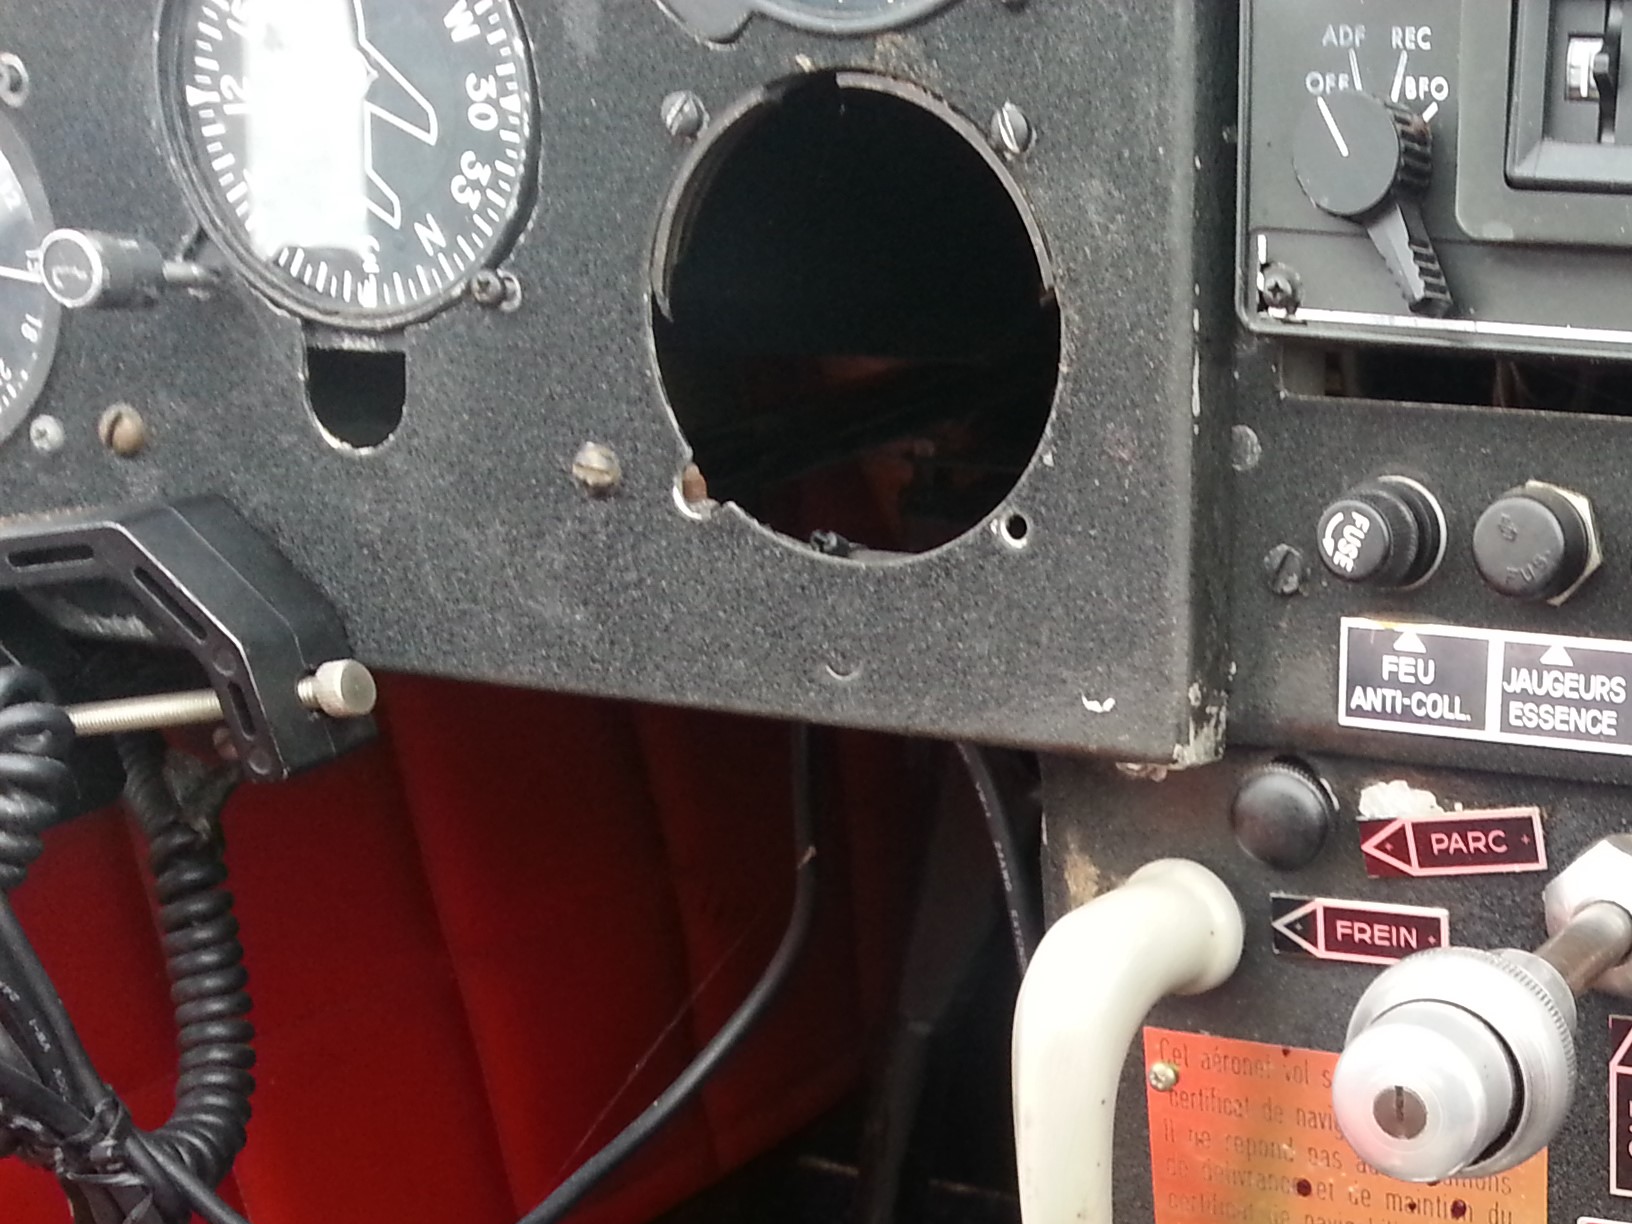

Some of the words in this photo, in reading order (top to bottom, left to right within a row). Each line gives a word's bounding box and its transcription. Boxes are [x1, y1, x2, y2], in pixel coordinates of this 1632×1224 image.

[1322, 23, 1366, 48] ADF
[1392, 25, 1432, 50] REC
[1305, 71, 1350, 95] OFF
[1404, 75, 1449, 101] BFO
[465, 72, 499, 131] 30
[450, 150, 492, 211] 33
[413, 212, 447, 257] N
[1333, 510, 1370, 573] FUSE
[1382, 655, 1435, 684] FEU
[1503, 668, 1627, 703] JAUGEURS
[1351, 686, 1472, 722] ANTI-COLL.
[1509, 702, 1618, 736] ESSENCE
[1430, 829, 1509, 856] PARC
[1335, 919, 1418, 948] FREIN
[1263, 1096, 1284, 1125] de
[1385, 1189, 1474, 1224] maintin
